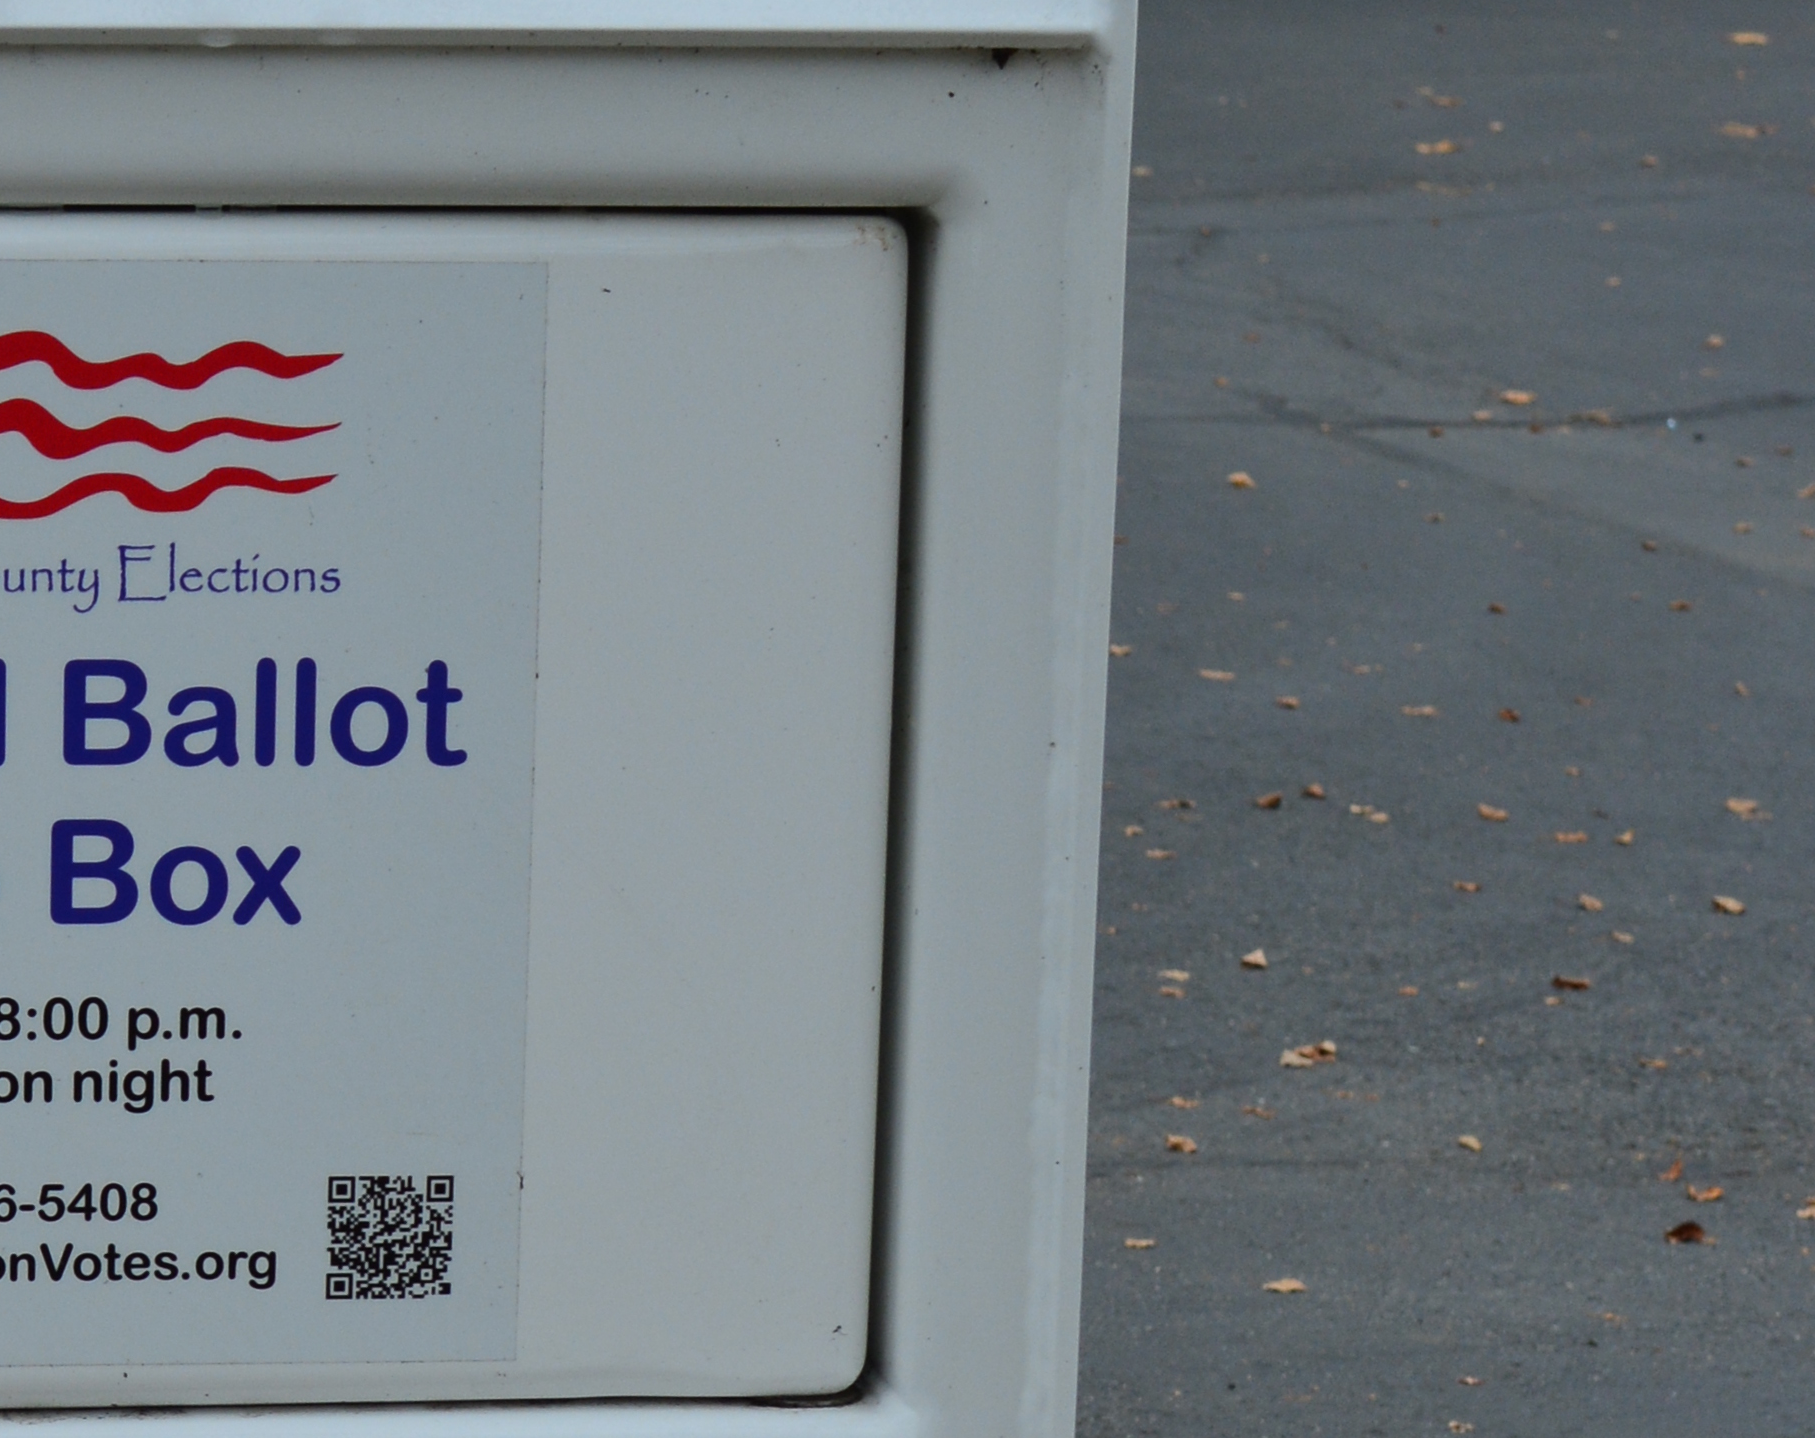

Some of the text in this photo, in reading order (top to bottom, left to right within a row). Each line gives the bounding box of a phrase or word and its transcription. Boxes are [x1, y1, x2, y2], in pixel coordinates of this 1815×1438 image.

[117, 542, 342, 602] Elections
[63, 657, 467, 767] Ballot
[50, 819, 302, 925] Box
[128, 1007, 242, 1051] p.m.
[73, 1059, 214, 1114] night
